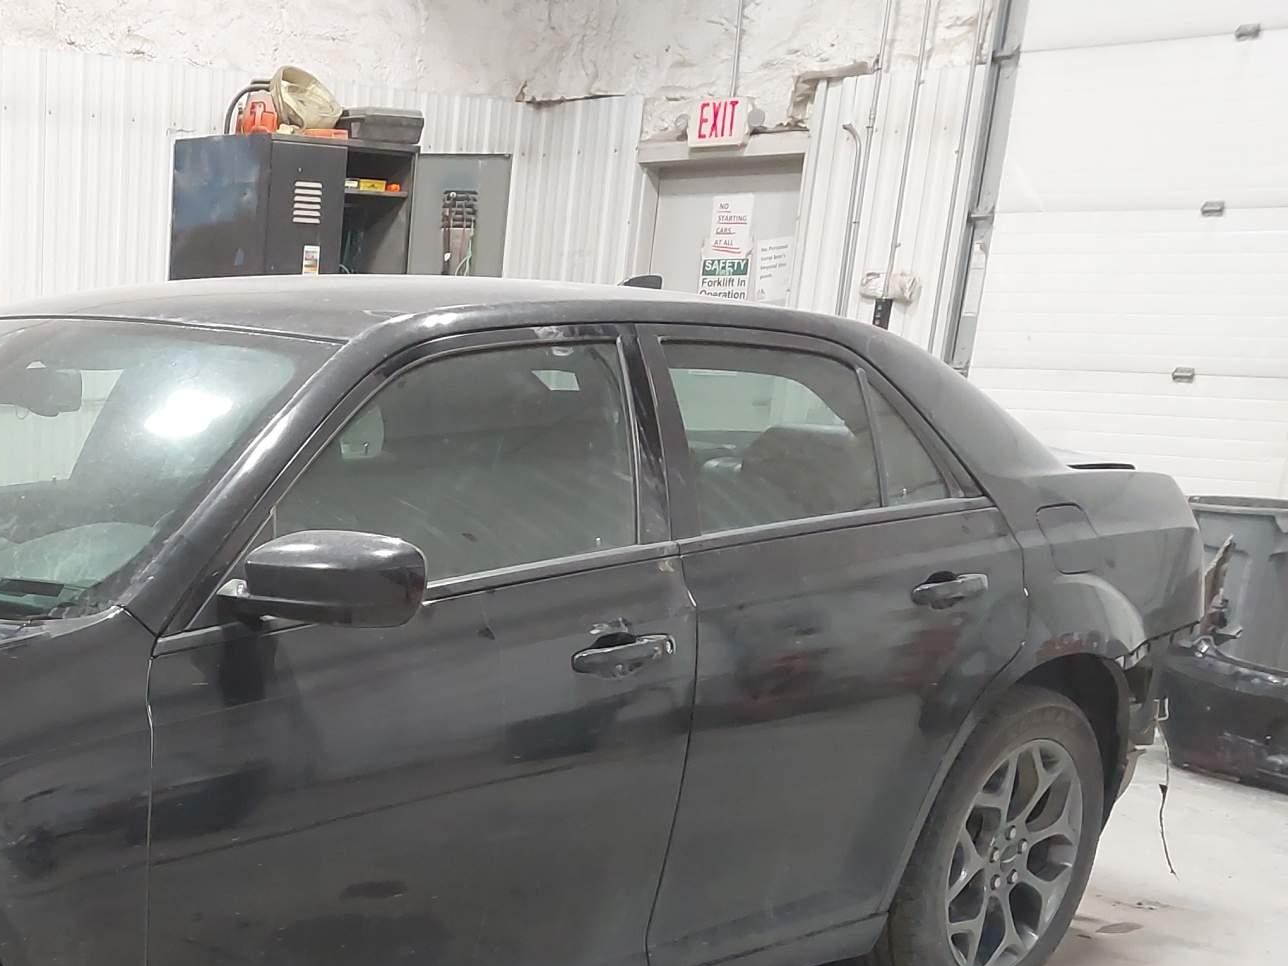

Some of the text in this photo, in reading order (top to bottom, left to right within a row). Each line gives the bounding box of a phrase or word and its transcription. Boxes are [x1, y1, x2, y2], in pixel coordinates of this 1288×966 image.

[698, 100, 739, 139] EXIT
[719, 202, 730, 210] NO
[705, 259, 747, 271] SAFETY
[701, 277, 746, 287] Forklift In
